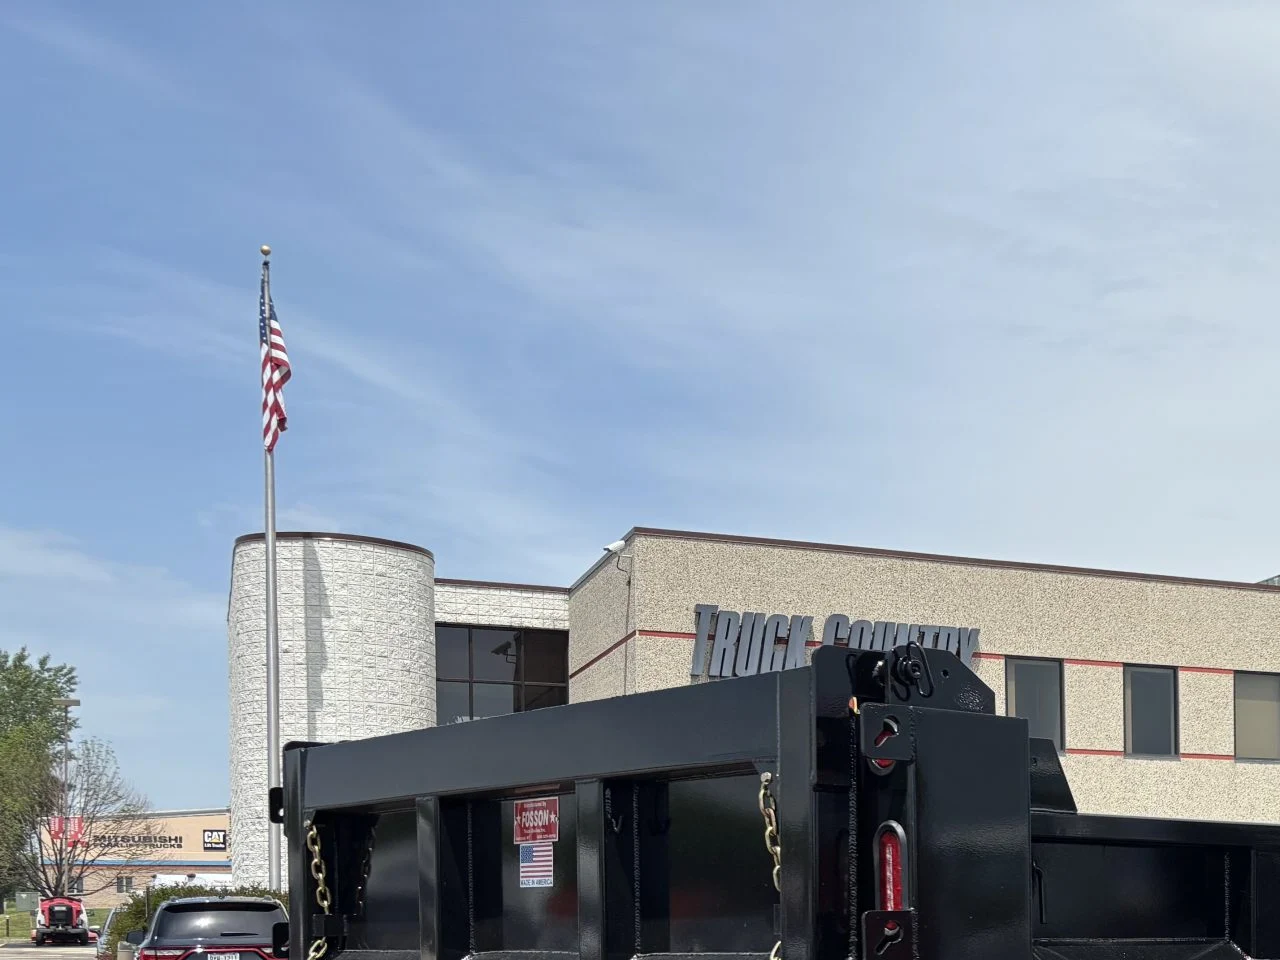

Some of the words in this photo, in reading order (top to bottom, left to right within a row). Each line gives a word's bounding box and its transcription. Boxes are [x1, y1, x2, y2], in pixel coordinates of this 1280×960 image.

[690, 604, 814, 677] TRUCK
[521, 810, 549, 828] FOSSON
[93, 835, 183, 844] MITSUBISHI
[204, 831, 225, 843] CAT
